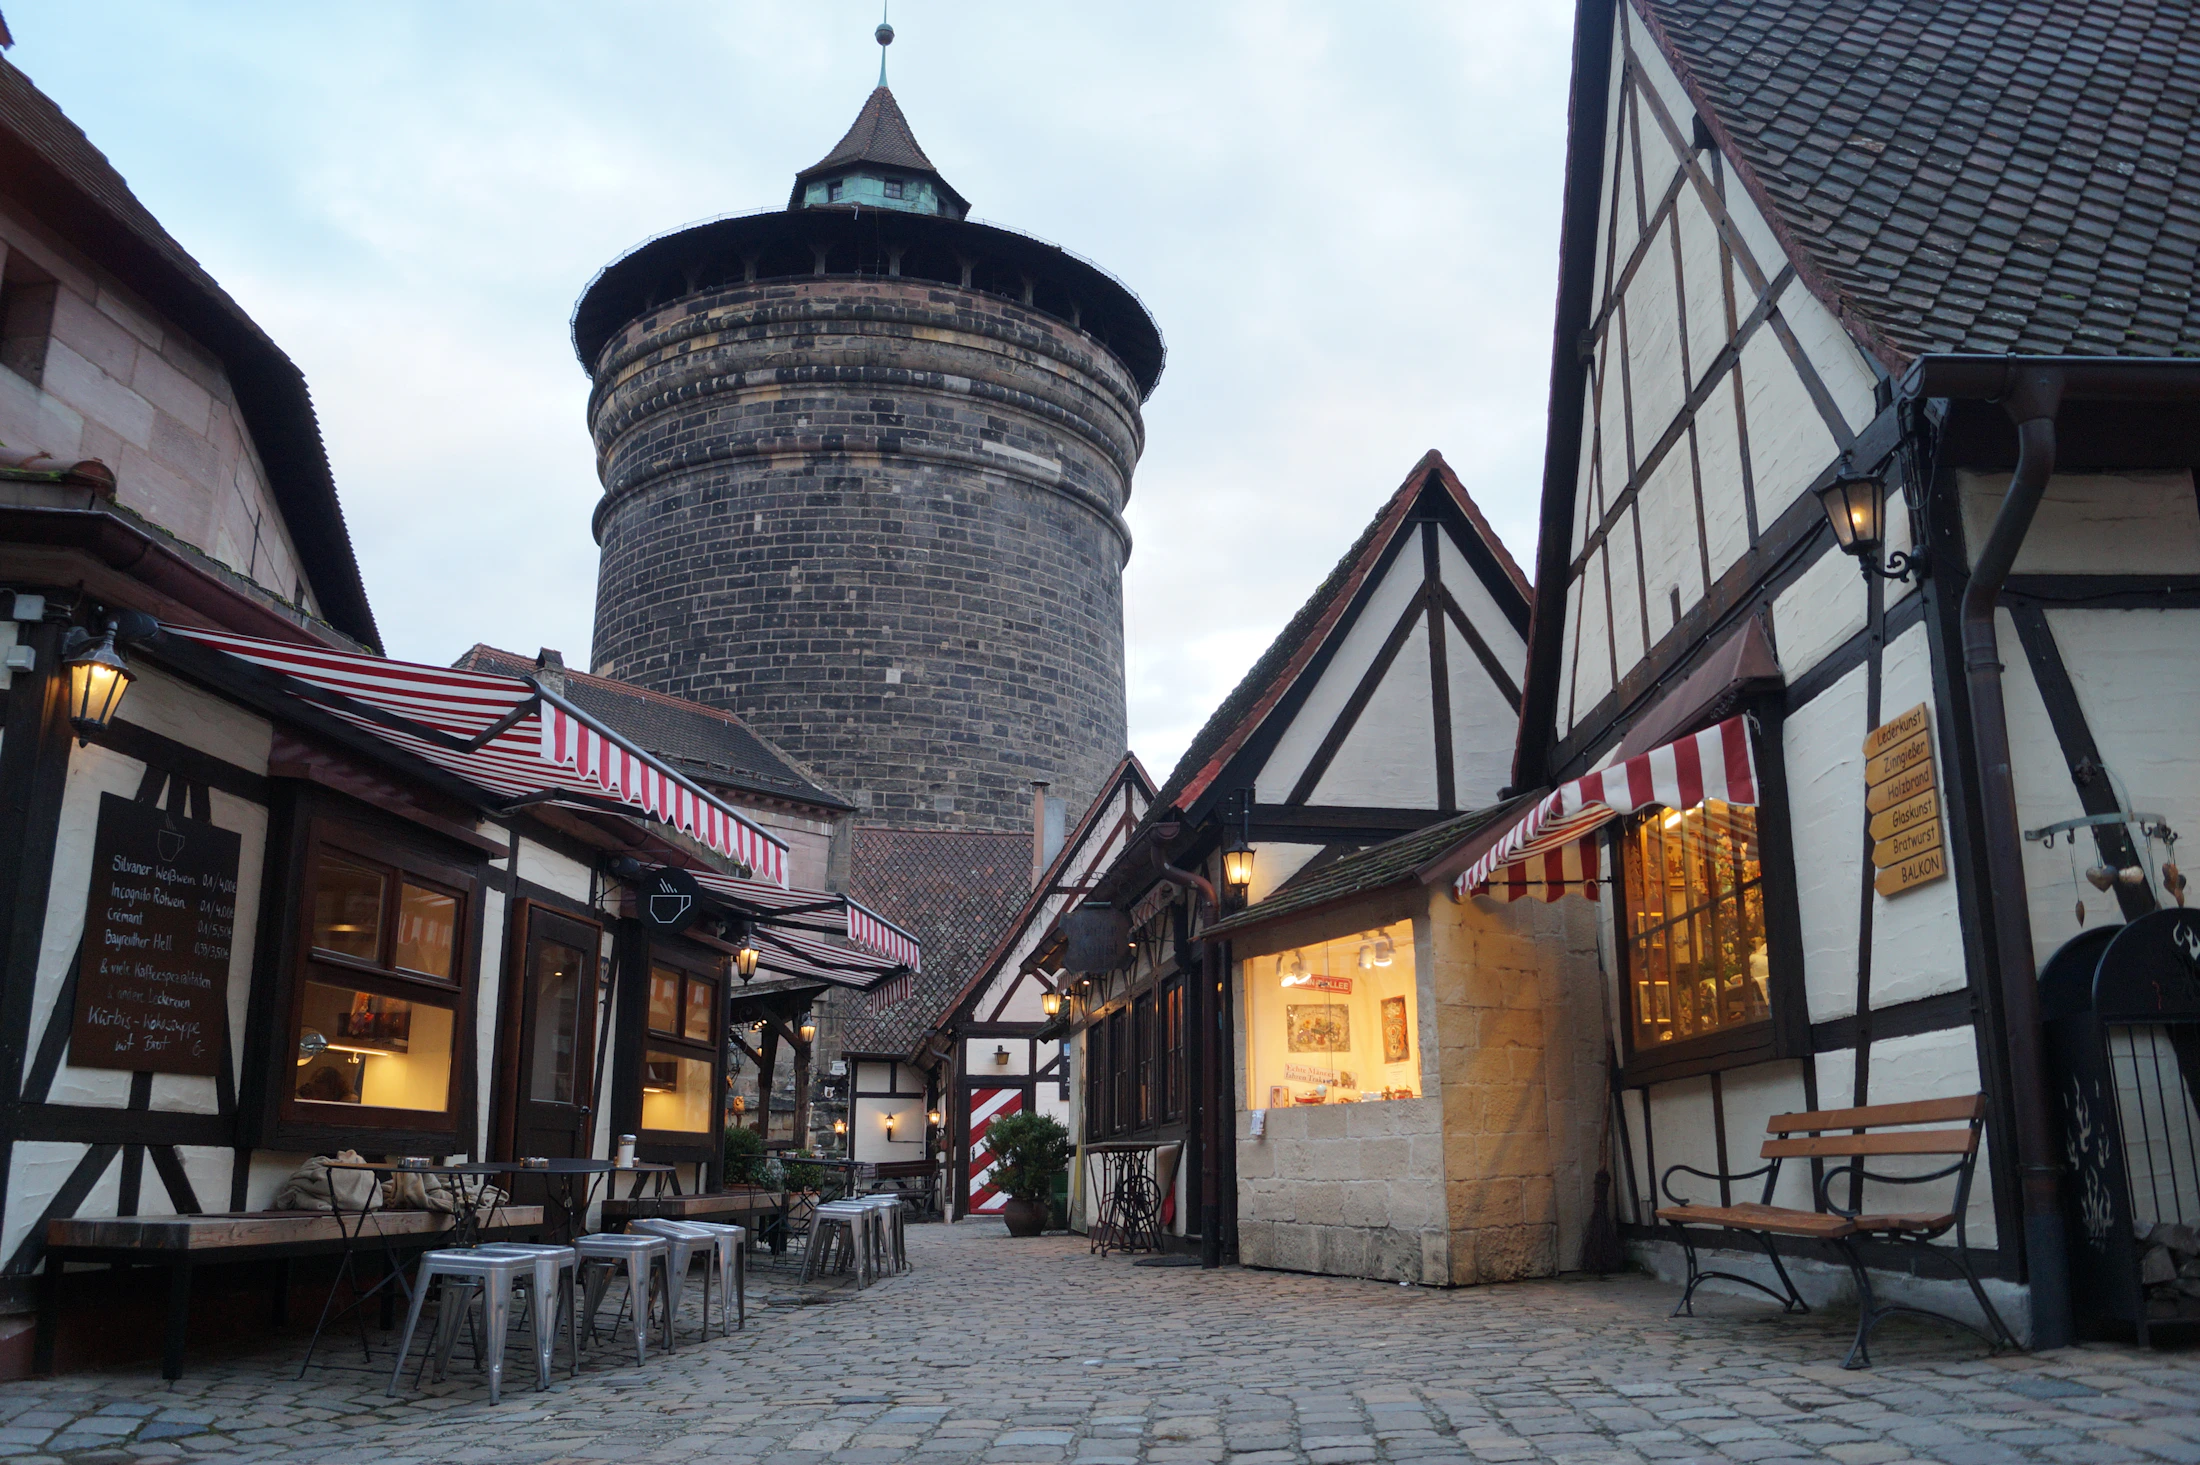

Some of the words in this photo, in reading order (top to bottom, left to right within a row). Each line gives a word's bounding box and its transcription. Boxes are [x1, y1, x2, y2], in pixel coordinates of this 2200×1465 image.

[1877, 710, 1921, 747] Lederkunst
[1883, 741, 1925, 774] Zinngießer
[1887, 766, 1929, 801] Holzbrand
[1892, 799, 1932, 828] Glaskunst
[1893, 826, 1935, 855] Bratwurst
[112, 854, 152, 876] Silvaner
[1901, 854, 1940, 883] BALKON
[111, 881, 151, 908] Incognito
[153, 886, 186, 910] Rotwein
[107, 908, 144, 926] Crémant
[105, 928, 151, 952] Bayreuther
[153, 933, 173, 952] Hell
[100, 957, 108, 975] &
[88, 1005, 132, 1030] Kürbis
[115, 1032, 135, 1052] mit
[143, 1034, 171, 1052] Brot
